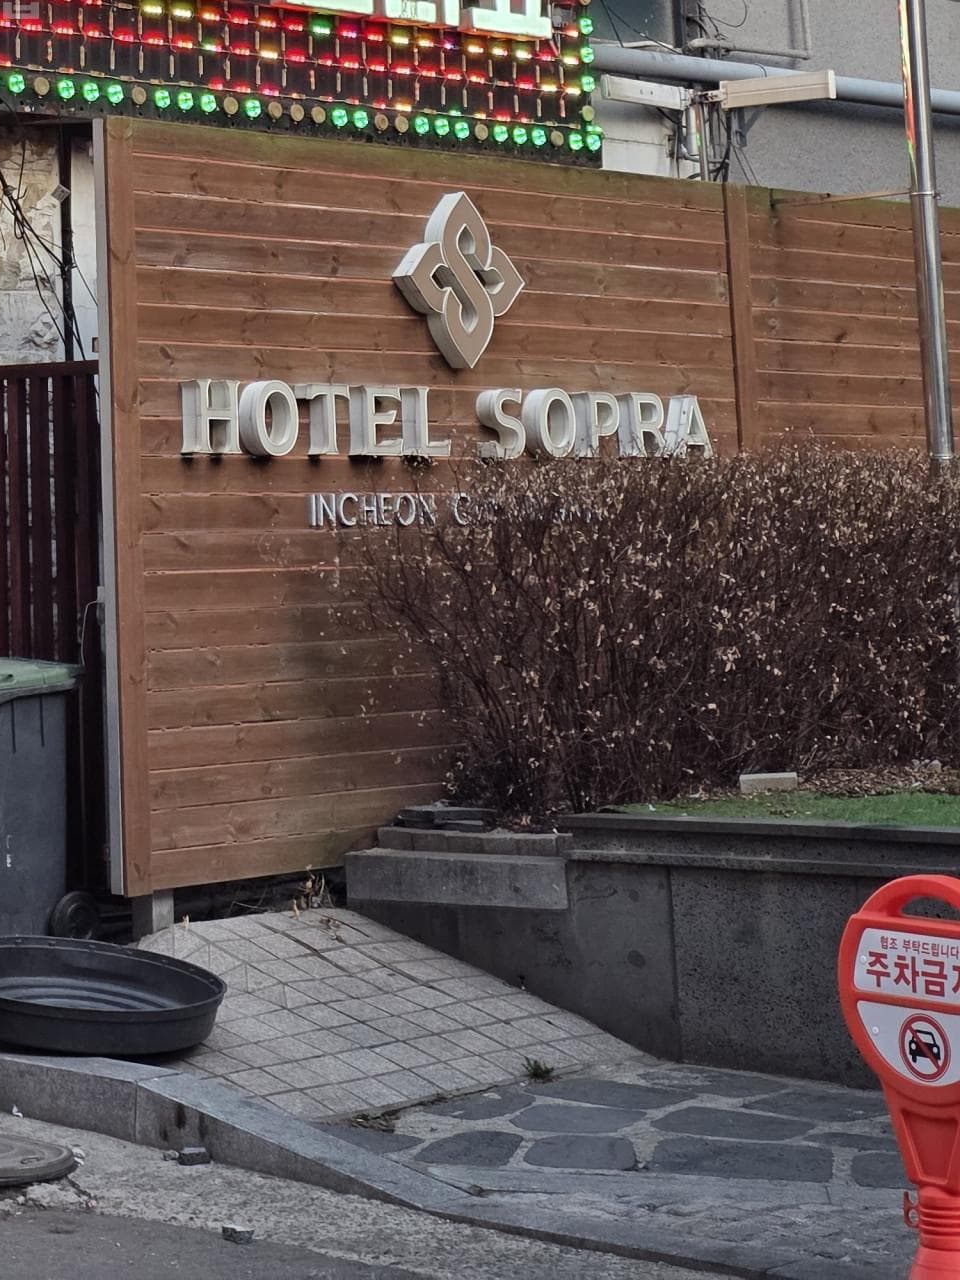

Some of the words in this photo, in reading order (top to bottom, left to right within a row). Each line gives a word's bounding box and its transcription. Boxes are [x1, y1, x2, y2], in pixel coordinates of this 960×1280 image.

[180, 377, 452, 458] HOTEL
[477, 386, 715, 462] SOPRA
[308, 491, 438, 528] INCHEON
[880, 935, 898, 950] 협조
